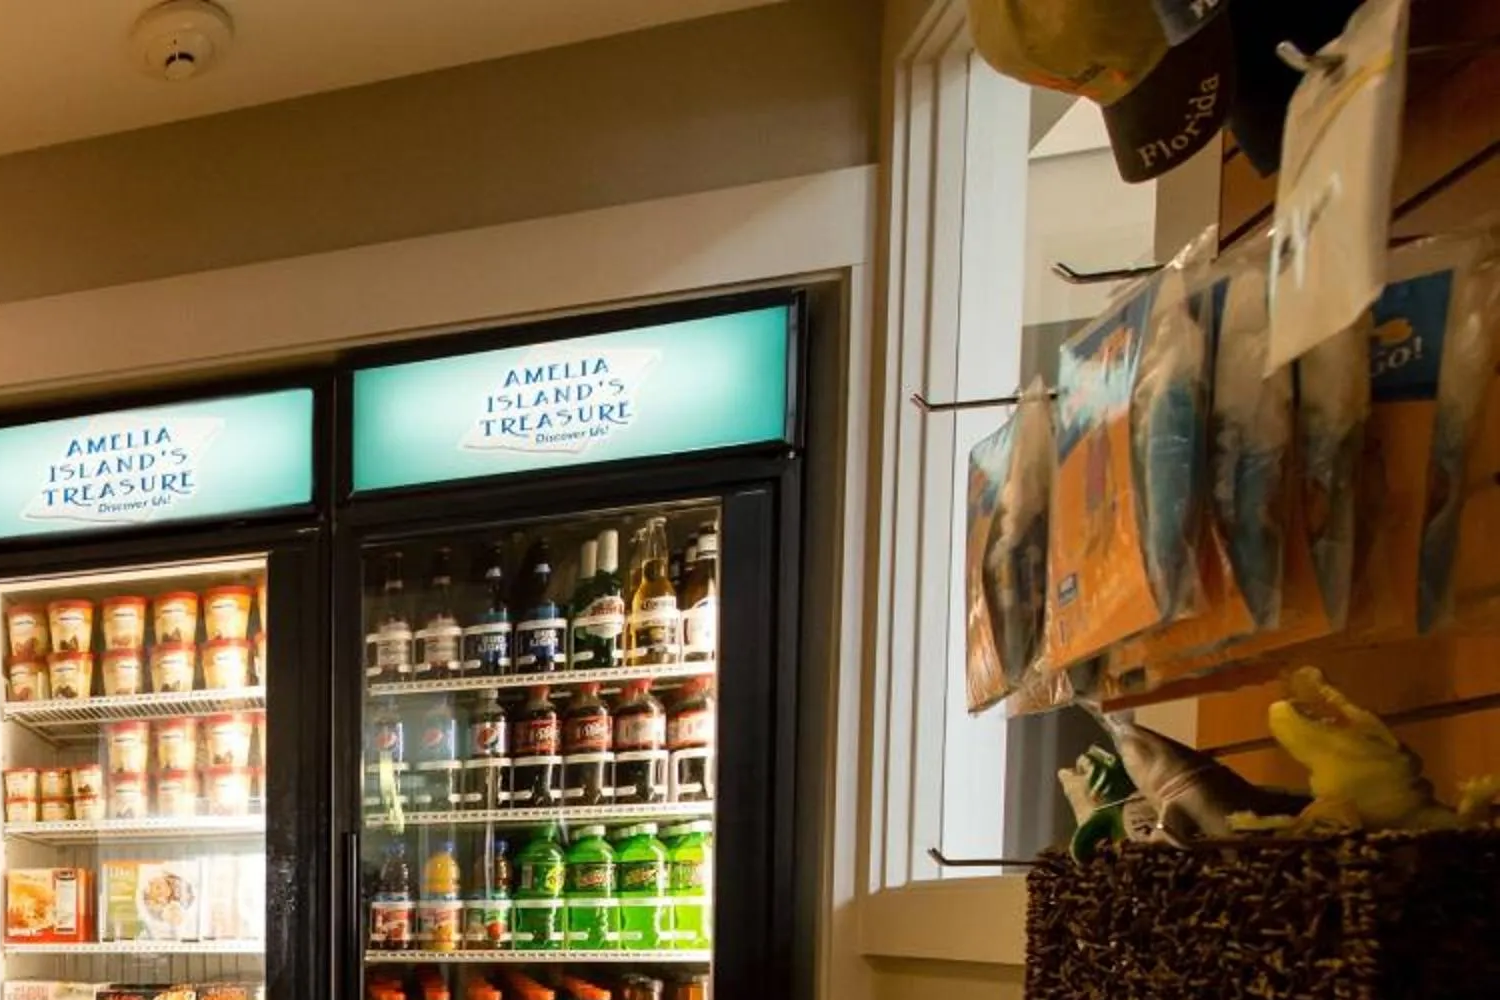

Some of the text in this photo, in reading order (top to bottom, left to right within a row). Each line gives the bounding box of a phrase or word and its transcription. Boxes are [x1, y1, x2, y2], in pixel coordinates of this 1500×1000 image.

[1137, 72, 1220, 169] Florida
[503, 356, 610, 389] AMELIA
[487, 379, 625, 413] ISLAND'S
[479, 401, 632, 438] TREASURE
[535, 424, 610, 444] Discover Us!
[66, 427, 172, 457] AMELIA
[49, 447, 188, 483] ISLAND'S
[41, 470, 195, 507] TREASURE
[97, 495, 172, 514] Discover Us!
